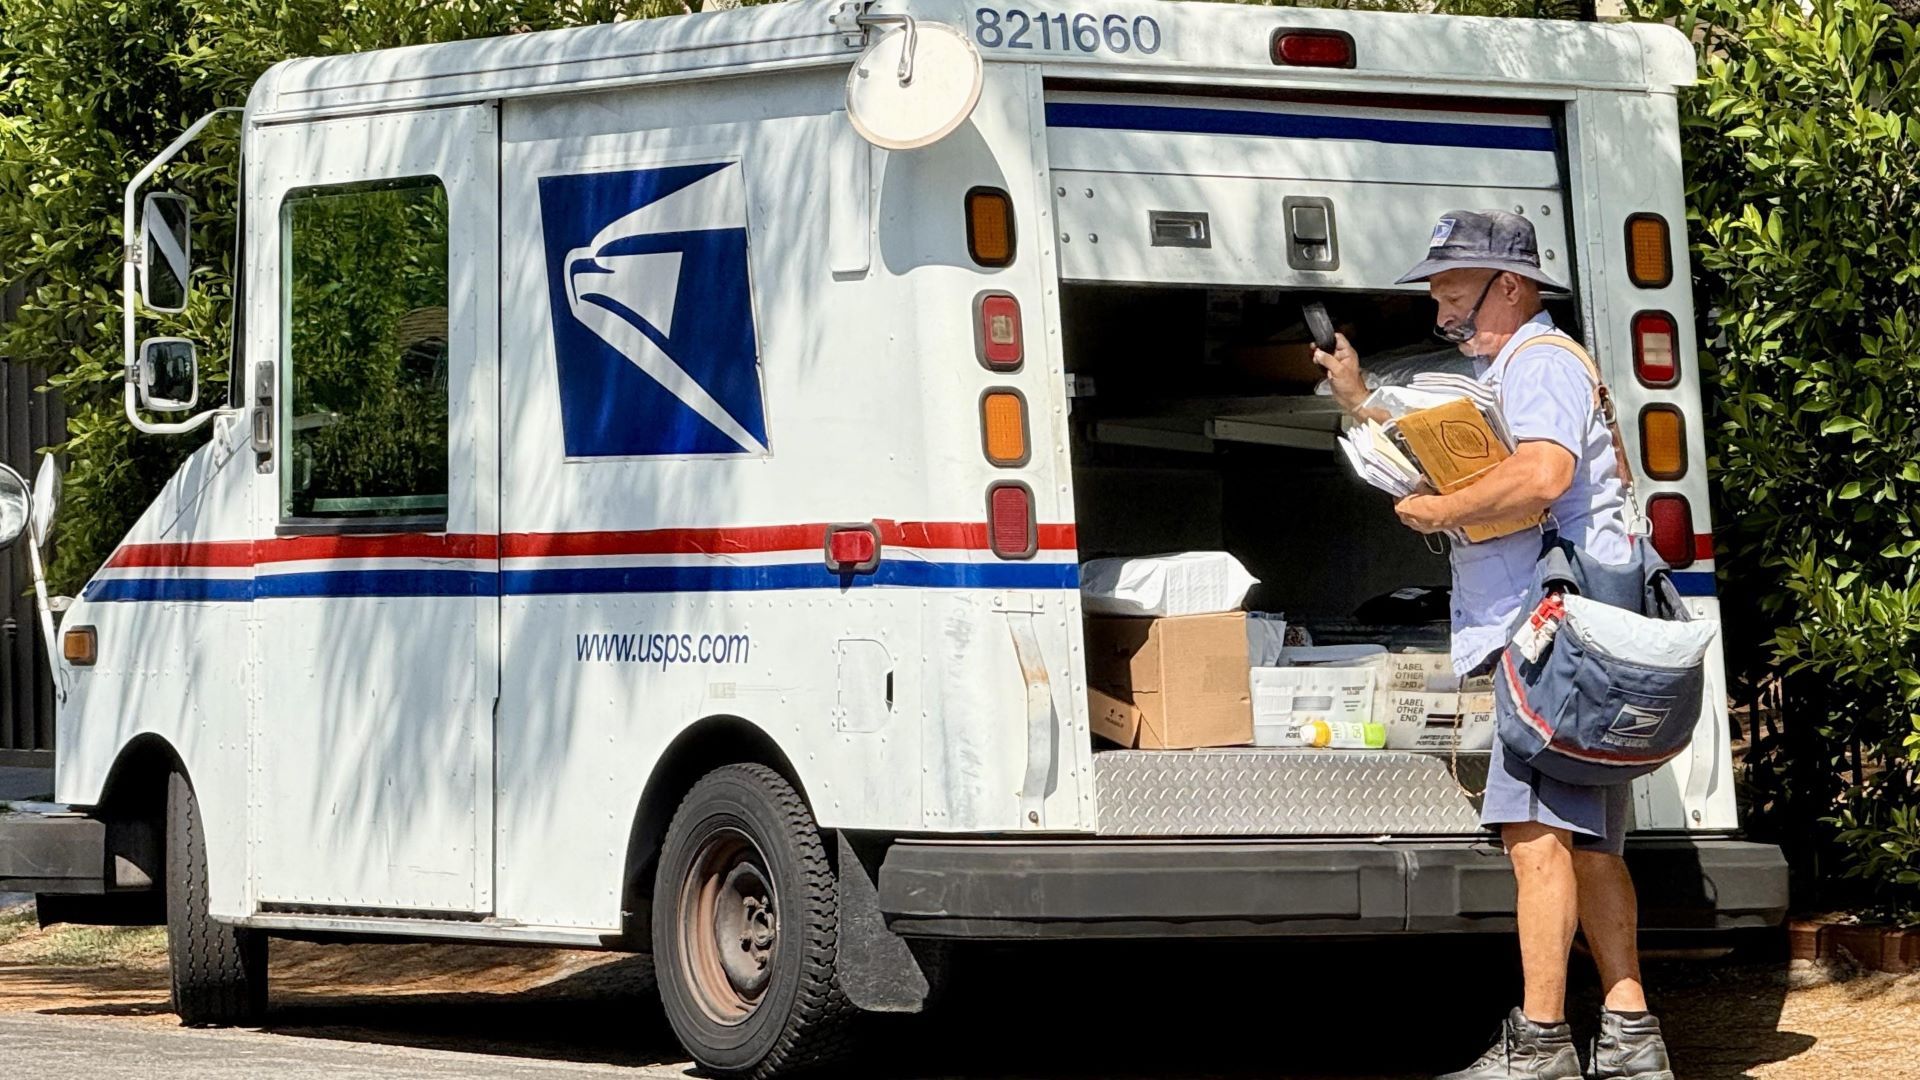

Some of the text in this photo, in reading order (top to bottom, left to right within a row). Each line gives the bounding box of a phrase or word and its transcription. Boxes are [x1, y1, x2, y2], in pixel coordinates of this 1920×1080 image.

[976, 7, 1161, 54] 8211660
[576, 633, 749, 672] www.usps.com
[1397, 663, 1424, 671] LABEL
[1395, 672, 1424, 680] OTHER
[1399, 698, 1424, 707] LABEL
[1396, 706, 1424, 715] OTHER
[1475, 715, 1490, 723] END
